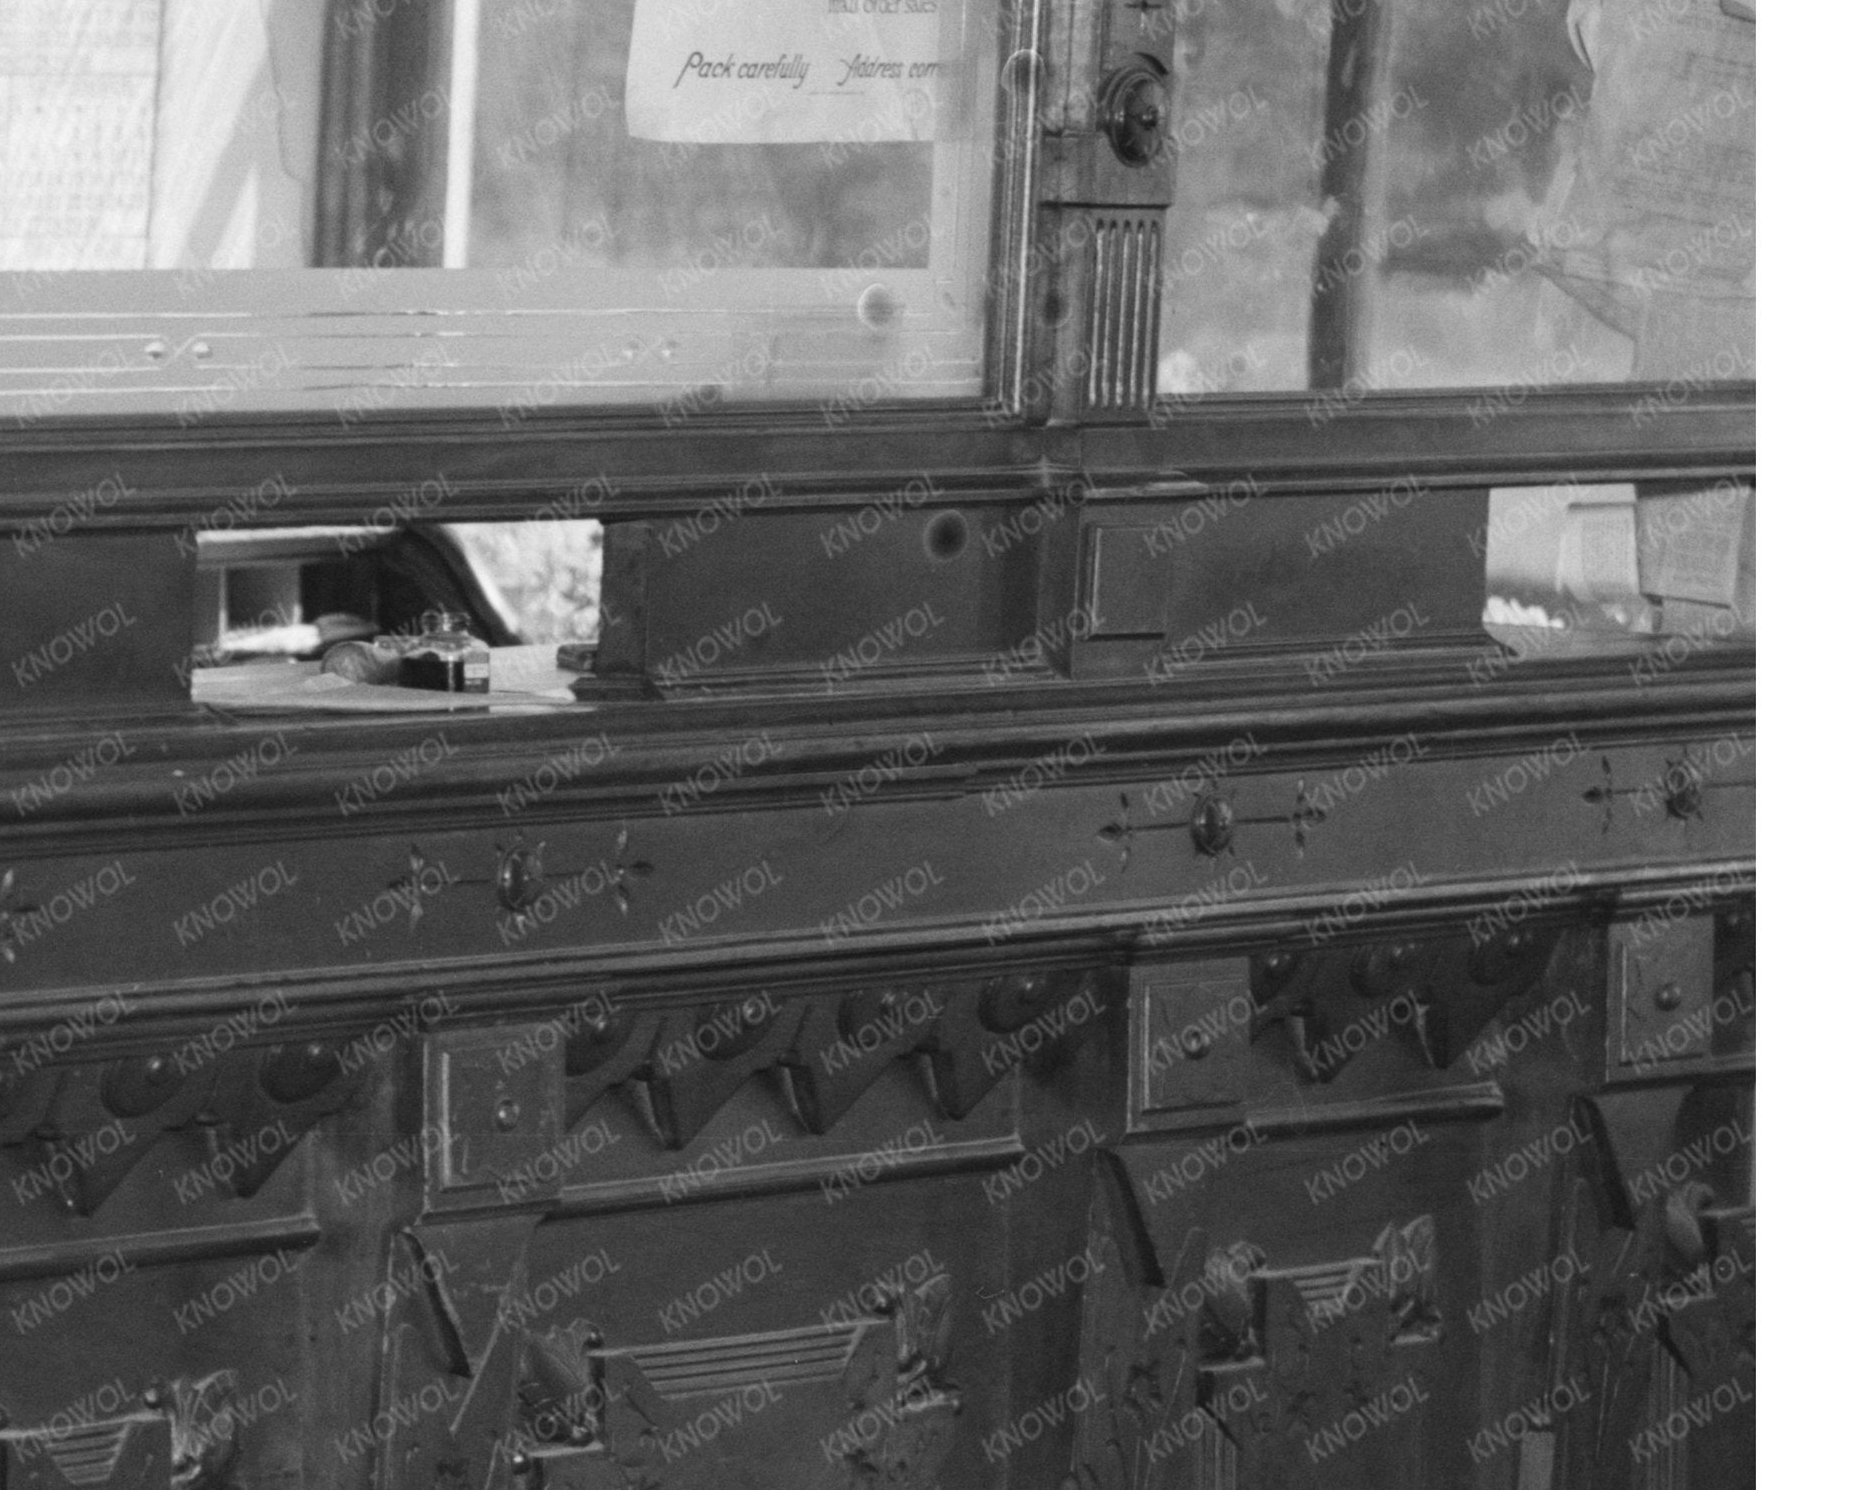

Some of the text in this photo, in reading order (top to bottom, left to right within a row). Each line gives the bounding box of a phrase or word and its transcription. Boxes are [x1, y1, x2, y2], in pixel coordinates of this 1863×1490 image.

[674, 50, 812, 90] Pack carefully
[836, 52, 905, 87] Address
